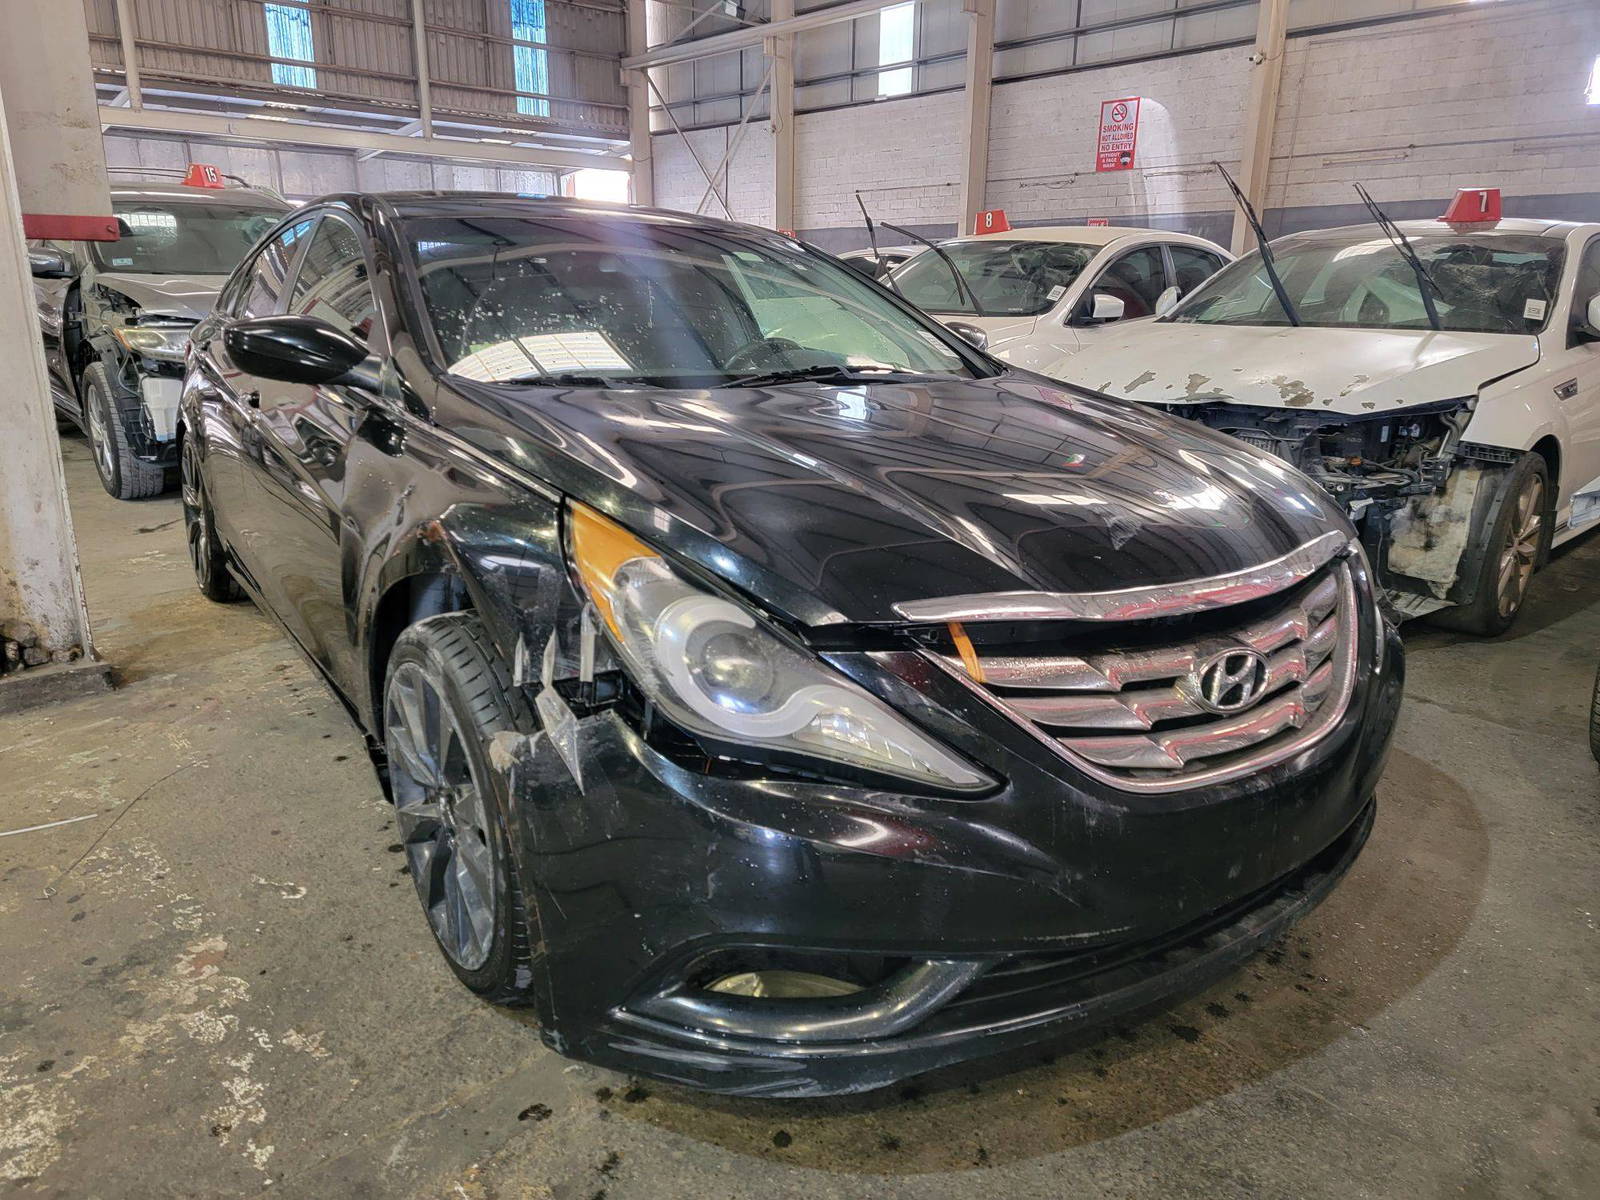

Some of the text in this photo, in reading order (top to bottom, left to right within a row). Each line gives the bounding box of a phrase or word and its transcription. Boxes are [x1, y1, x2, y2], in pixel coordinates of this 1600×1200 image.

[1103, 123, 1133, 132] SMOKING
[1102, 134, 1111, 142] NOT
[205, 167, 217, 182] 15
[1479, 191, 1487, 213] 7
[985, 212, 993, 228] 8
